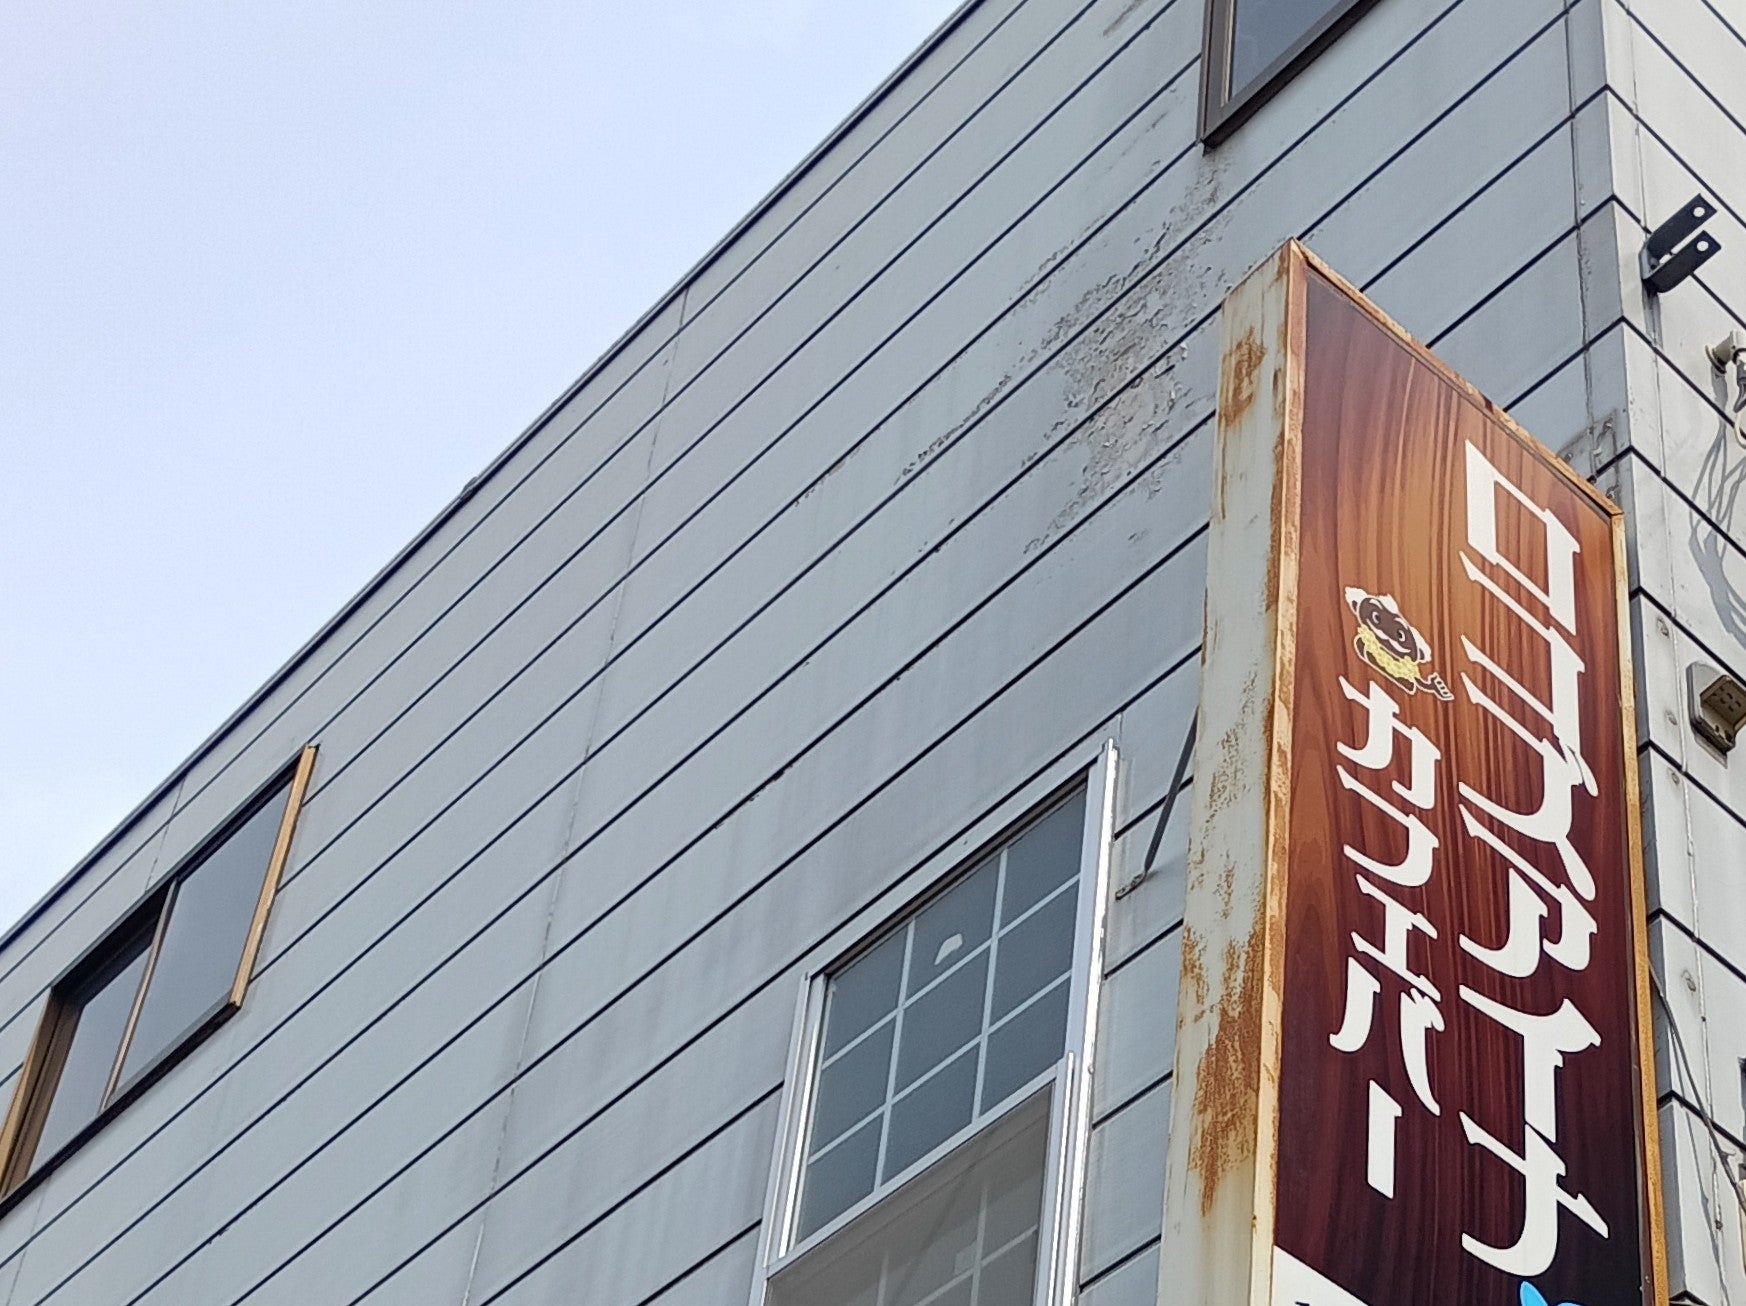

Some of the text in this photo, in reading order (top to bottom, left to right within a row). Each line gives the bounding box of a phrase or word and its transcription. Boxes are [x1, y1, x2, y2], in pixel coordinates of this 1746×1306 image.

[1330, 676, 1446, 1199] カフェバー
[1457, 438, 1608, 1277] ロコズアイナ
